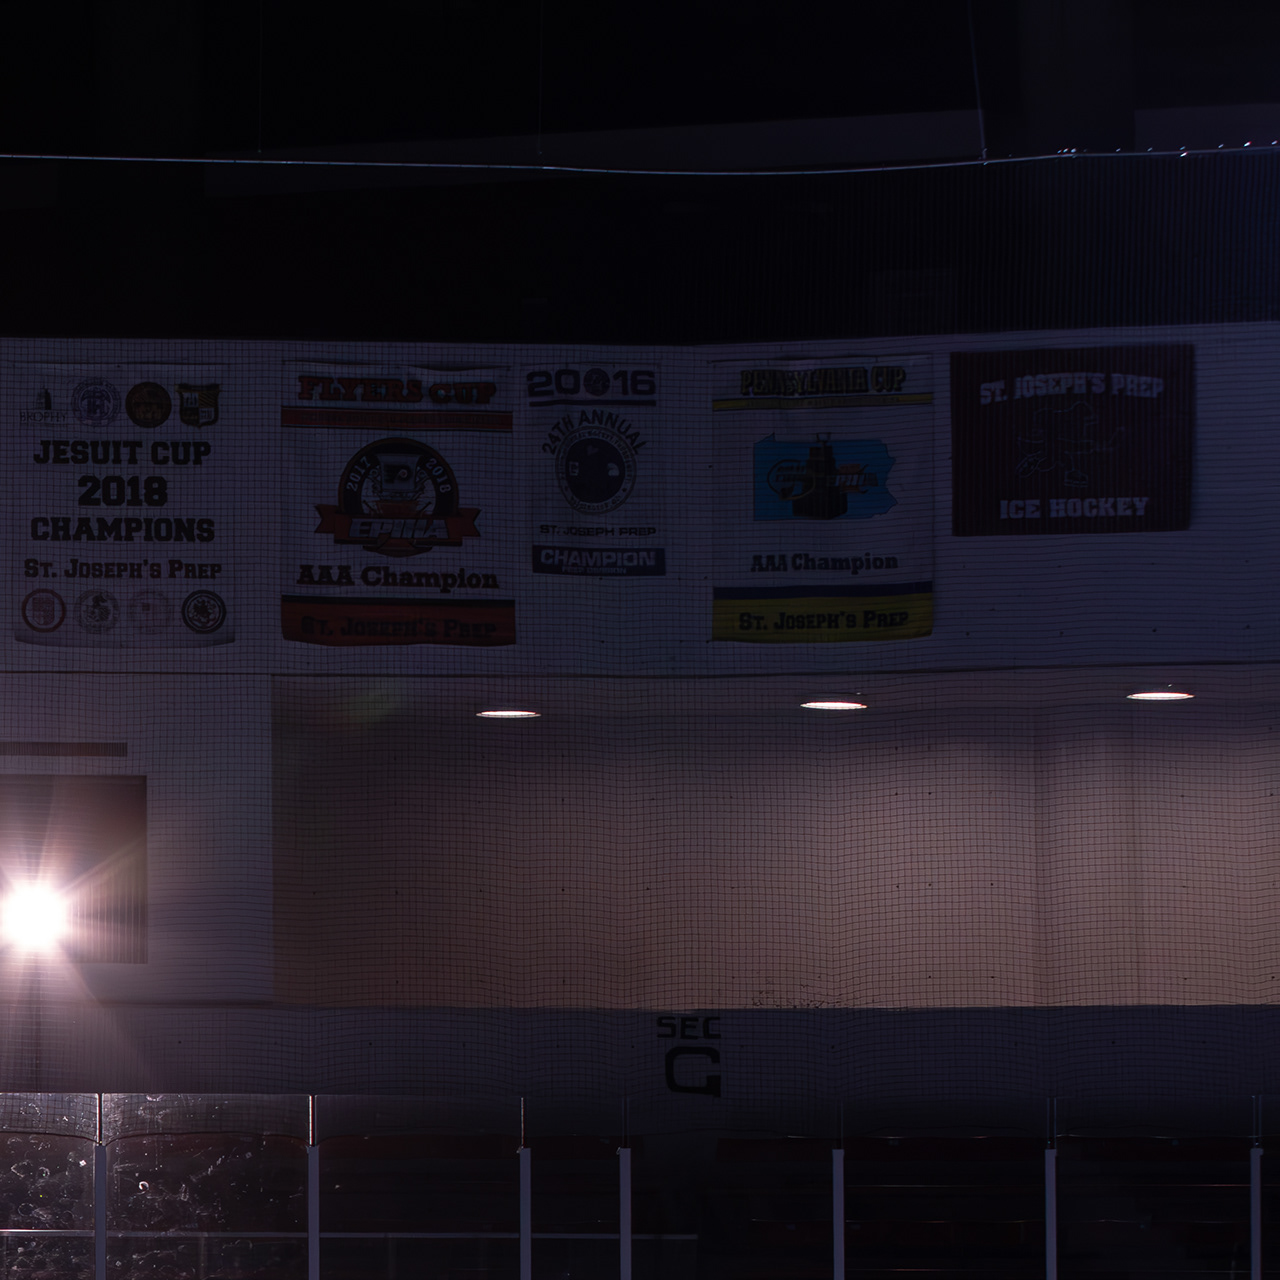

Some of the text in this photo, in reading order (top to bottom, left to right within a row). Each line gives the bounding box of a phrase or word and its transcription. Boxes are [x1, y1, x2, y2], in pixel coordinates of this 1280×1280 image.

[298, 376, 497, 404] FLYERS CUP
[741, 366, 906, 395] PENNSYLVANIA CUP
[980, 372, 1164, 405] ST. JOSEPH'S PREP
[19, 411, 65, 422] BROPHY
[542, 409, 648, 455] 24TH ANNUAL
[34, 440, 211, 465] JESUIT CUP
[346, 456, 452, 494] 2017 2018
[78, 475, 168, 506] 2018
[1000, 497, 1149, 519] ICE HOCKEY
[31, 517, 215, 542] CHAMPIONS
[563, 526, 614, 536] JOSEPH
[619, 527, 656, 536] PREP
[65, 559, 161, 578] JOSEPH'S
[169, 560, 222, 579] PREP
[541, 549, 656, 566] CHAMPION
[751, 553, 898, 575] AAA Champion
[297, 565, 499, 593] AAA Champion
[775, 611, 856, 630] JOSEPH'S
[863, 610, 908, 628] PREP
[657, 1016, 721, 1039] SEC
[665, 1046, 721, 1097] G
